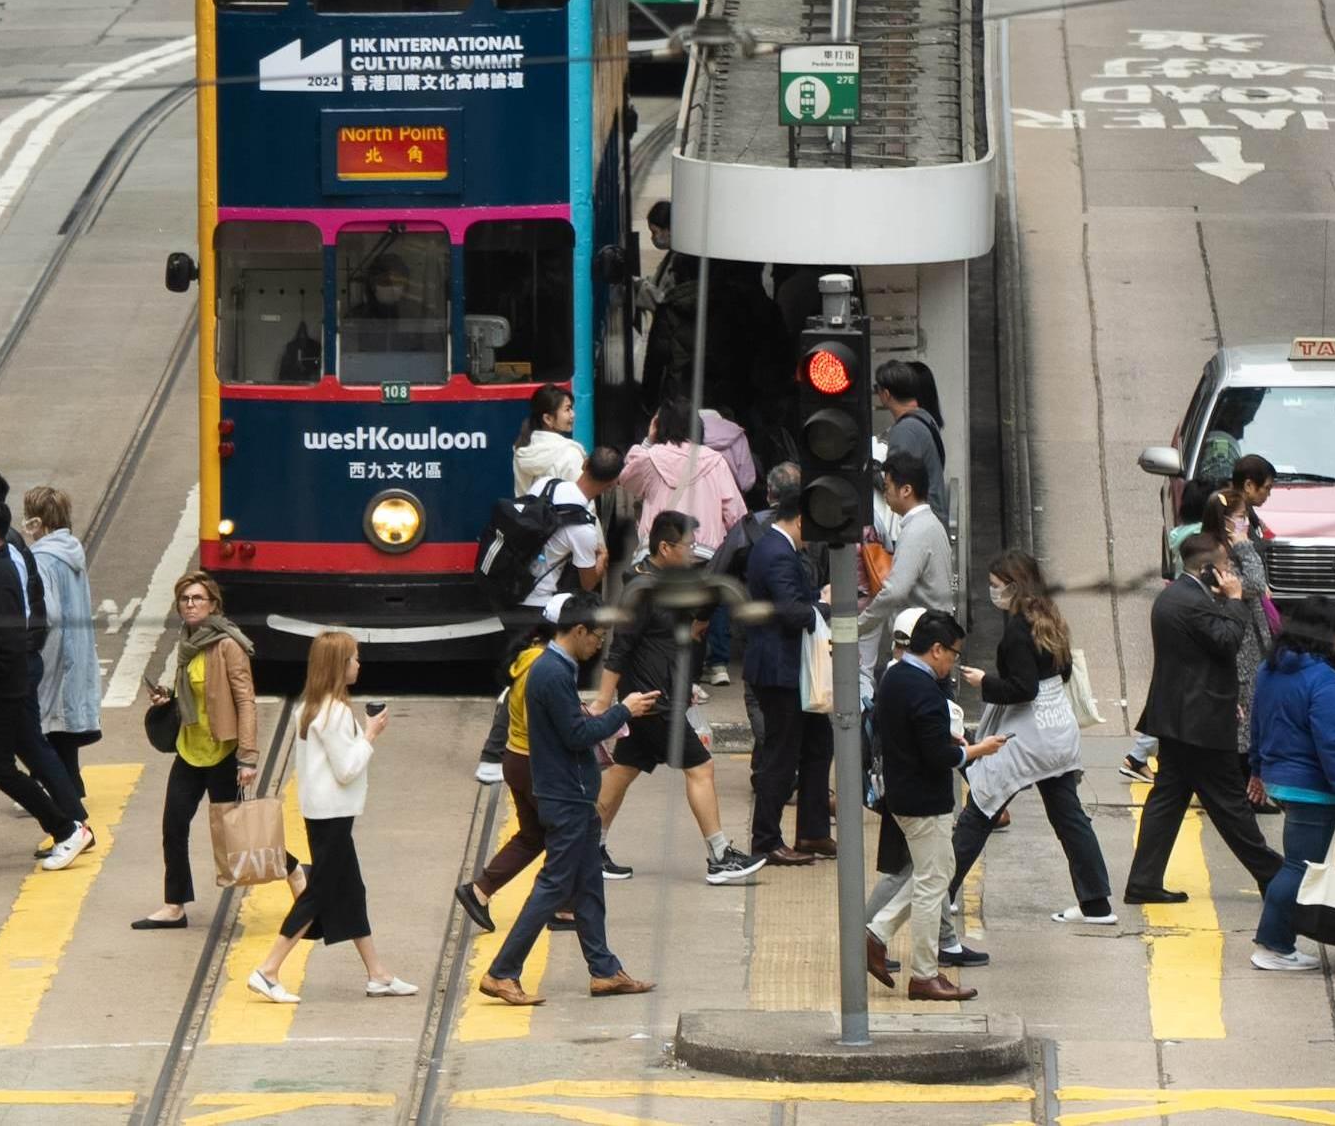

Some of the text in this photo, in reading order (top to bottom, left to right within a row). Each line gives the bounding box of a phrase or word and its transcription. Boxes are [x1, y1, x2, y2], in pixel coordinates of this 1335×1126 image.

[350, 35, 525, 53] HK INTERNATIONAL
[350, 54, 525, 71] CULTURAL SUMMIT
[307, 76, 338, 87] 2024
[351, 72, 525, 91] 香港國際文化高峰論壇
[836, 75, 855, 84] 27E
[341, 127, 445, 141] North Point
[384, 385, 408, 398] 108
[304, 426, 486, 450] westKowloon
[348, 462, 442, 480] 西九文化區
